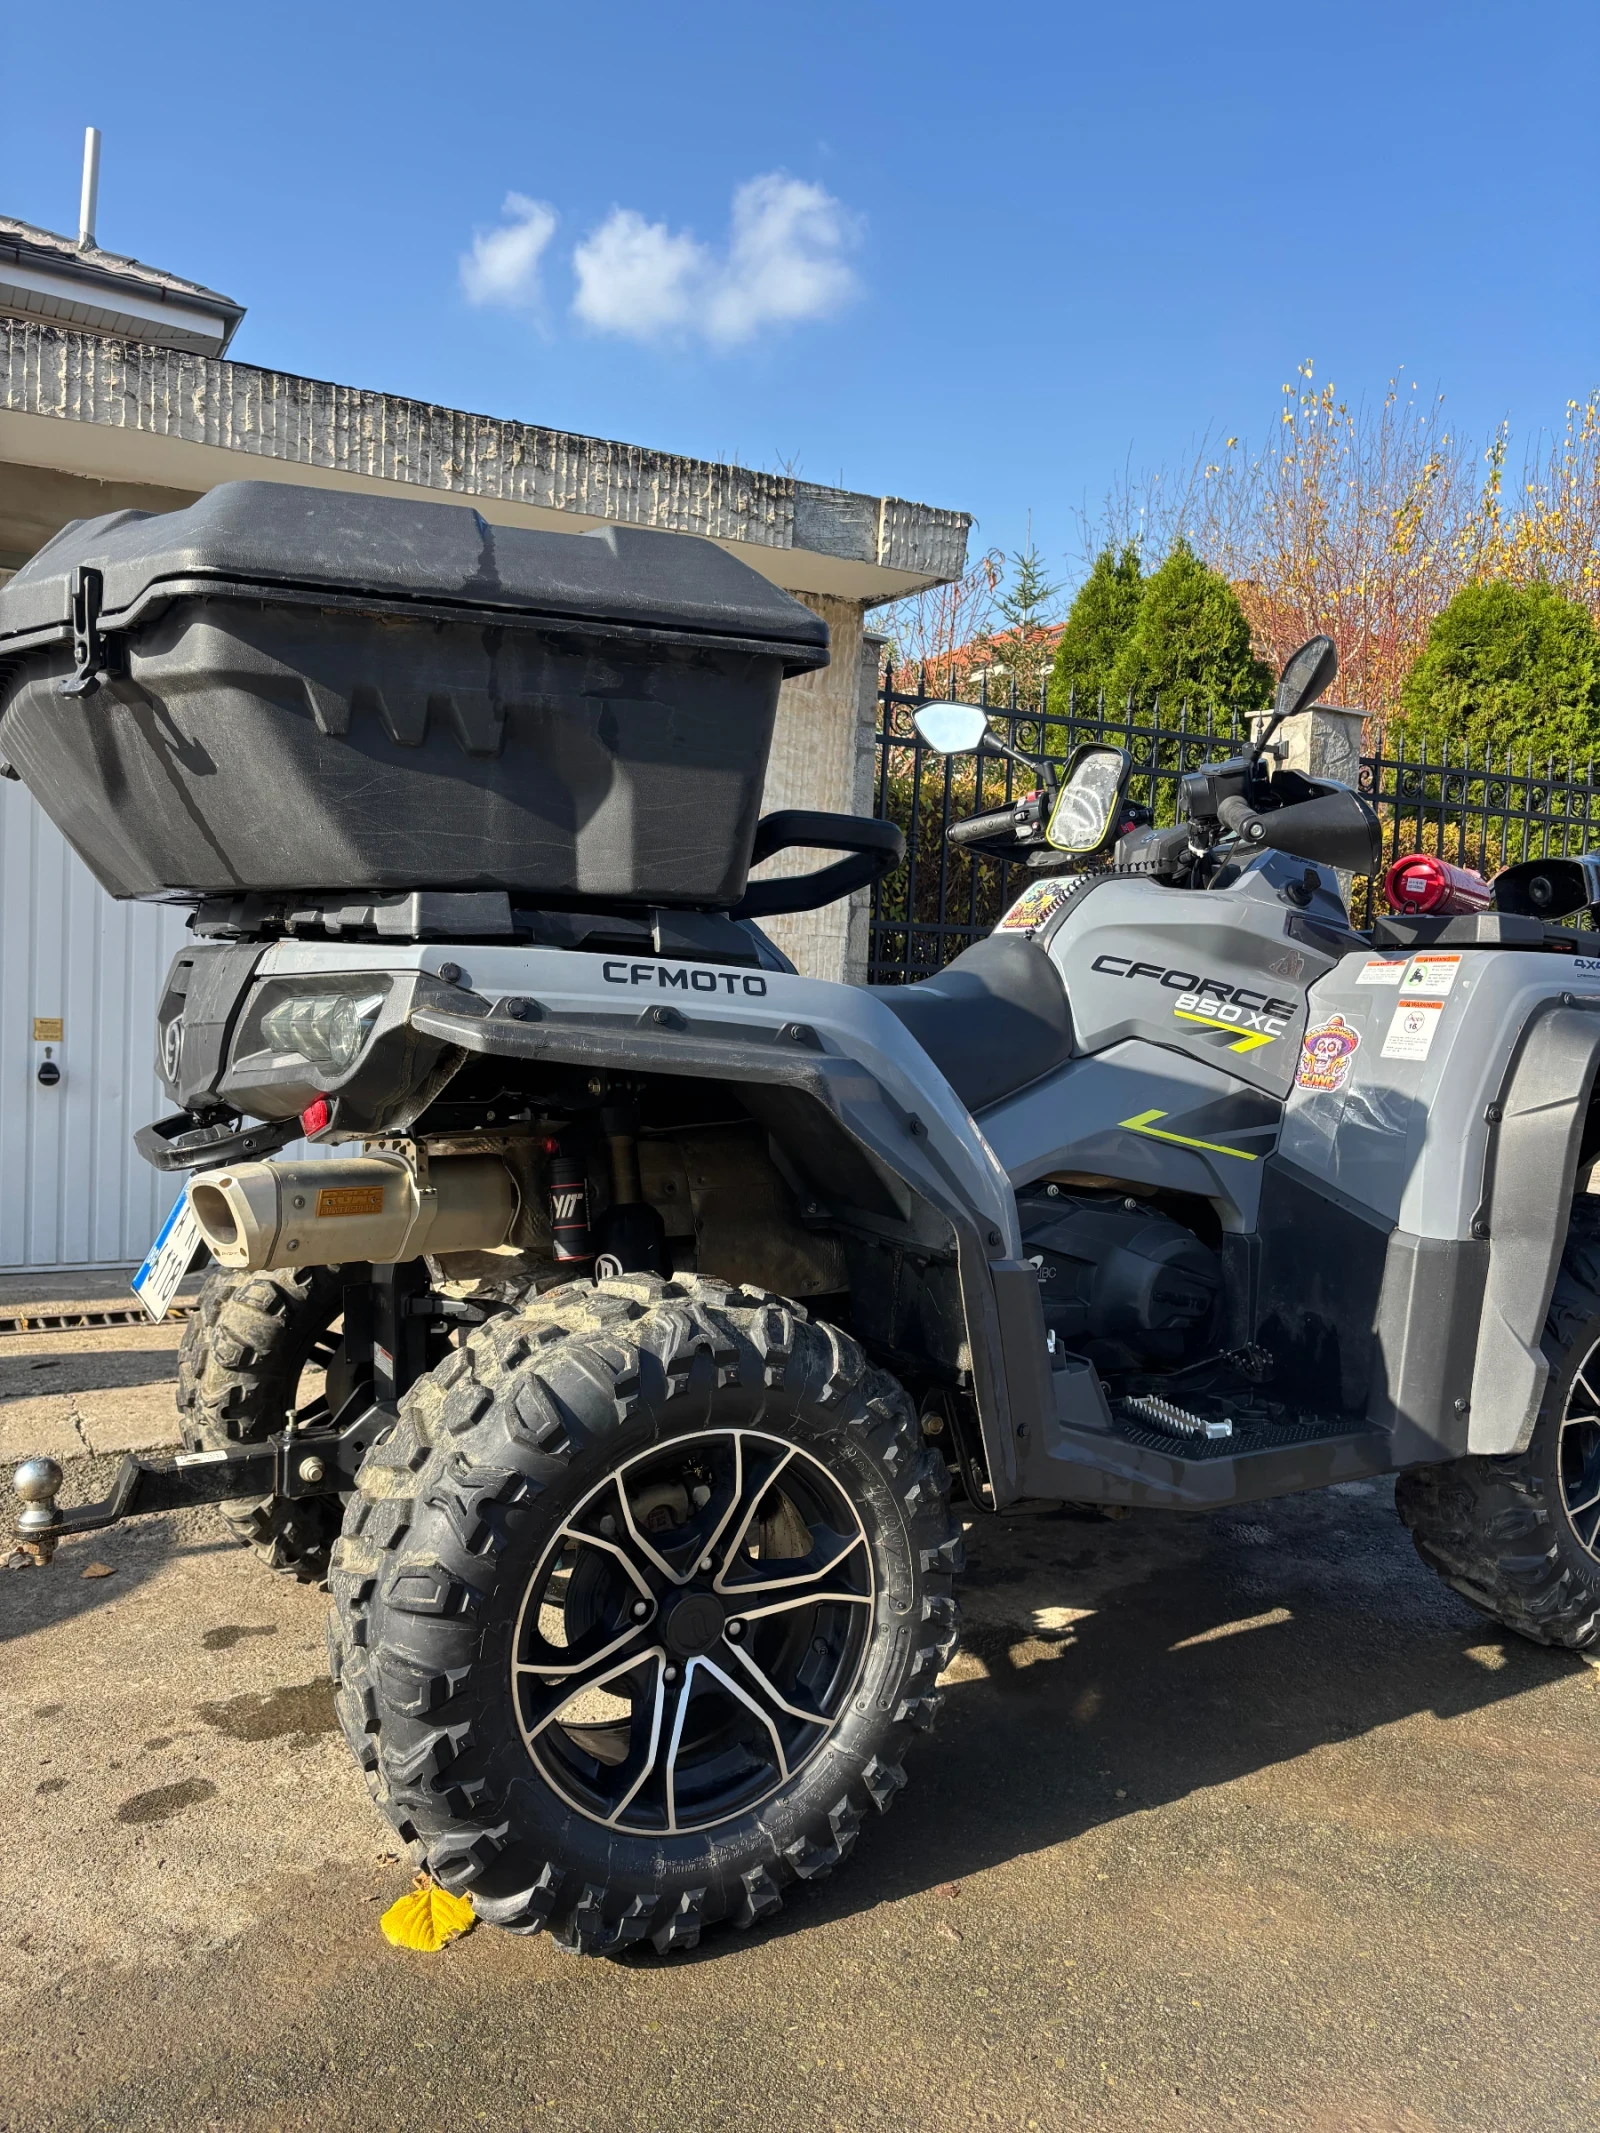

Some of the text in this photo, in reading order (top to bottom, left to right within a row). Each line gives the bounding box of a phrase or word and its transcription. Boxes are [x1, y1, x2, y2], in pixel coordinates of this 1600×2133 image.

[602, 961, 768, 997] CFMOTO
[1090, 954, 1299, 1021] CFORCE
[1174, 992, 1288, 1036] 850 XC
[1301, 1073, 1336, 1088] RJWC
